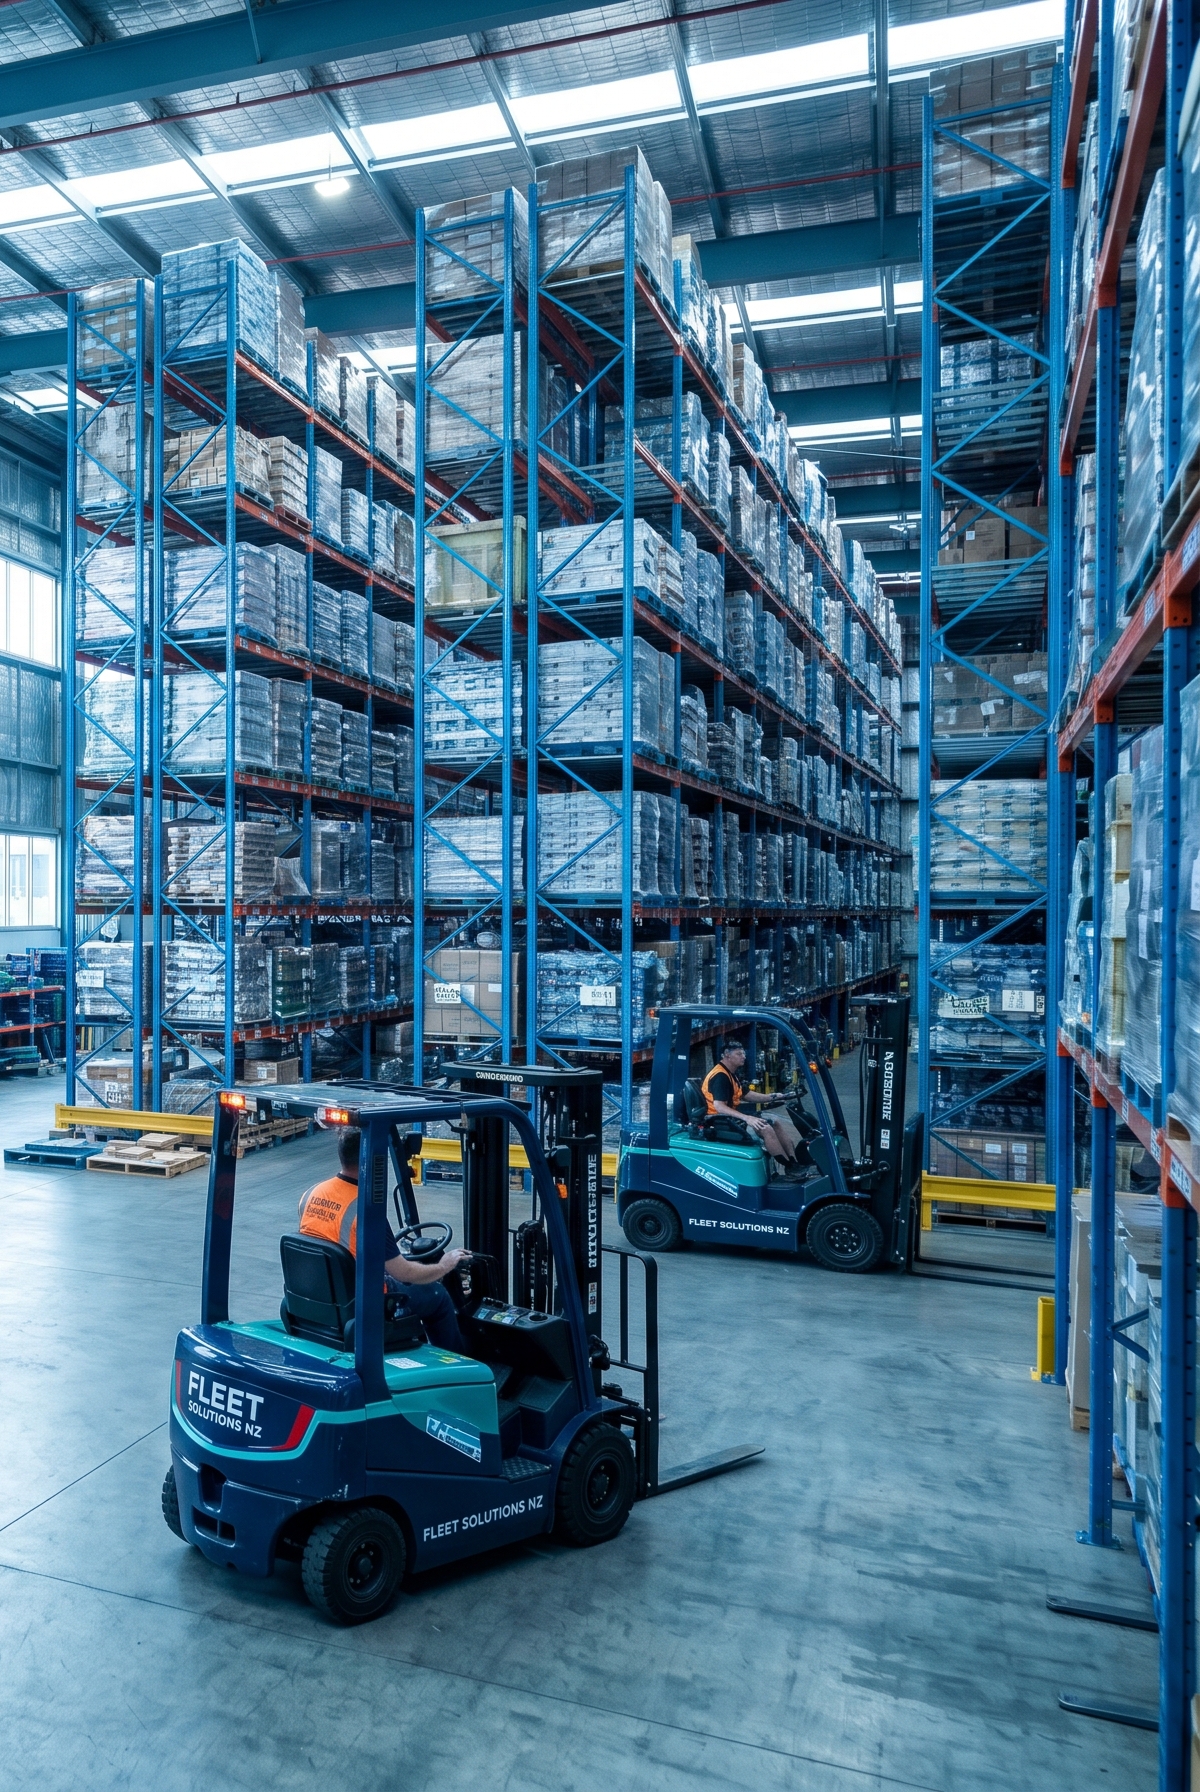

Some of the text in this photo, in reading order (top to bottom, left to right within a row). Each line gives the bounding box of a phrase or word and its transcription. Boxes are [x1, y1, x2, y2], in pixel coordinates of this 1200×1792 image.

[688, 1218, 718, 1228] FLEET
[776, 1227, 790, 1235] NZ
[188, 1370, 265, 1422] FLEET
[188, 1399, 263, 1438] SOLUTIONS NZ
[423, 1495, 544, 1542] FLEET SOLUTIONS NZ
